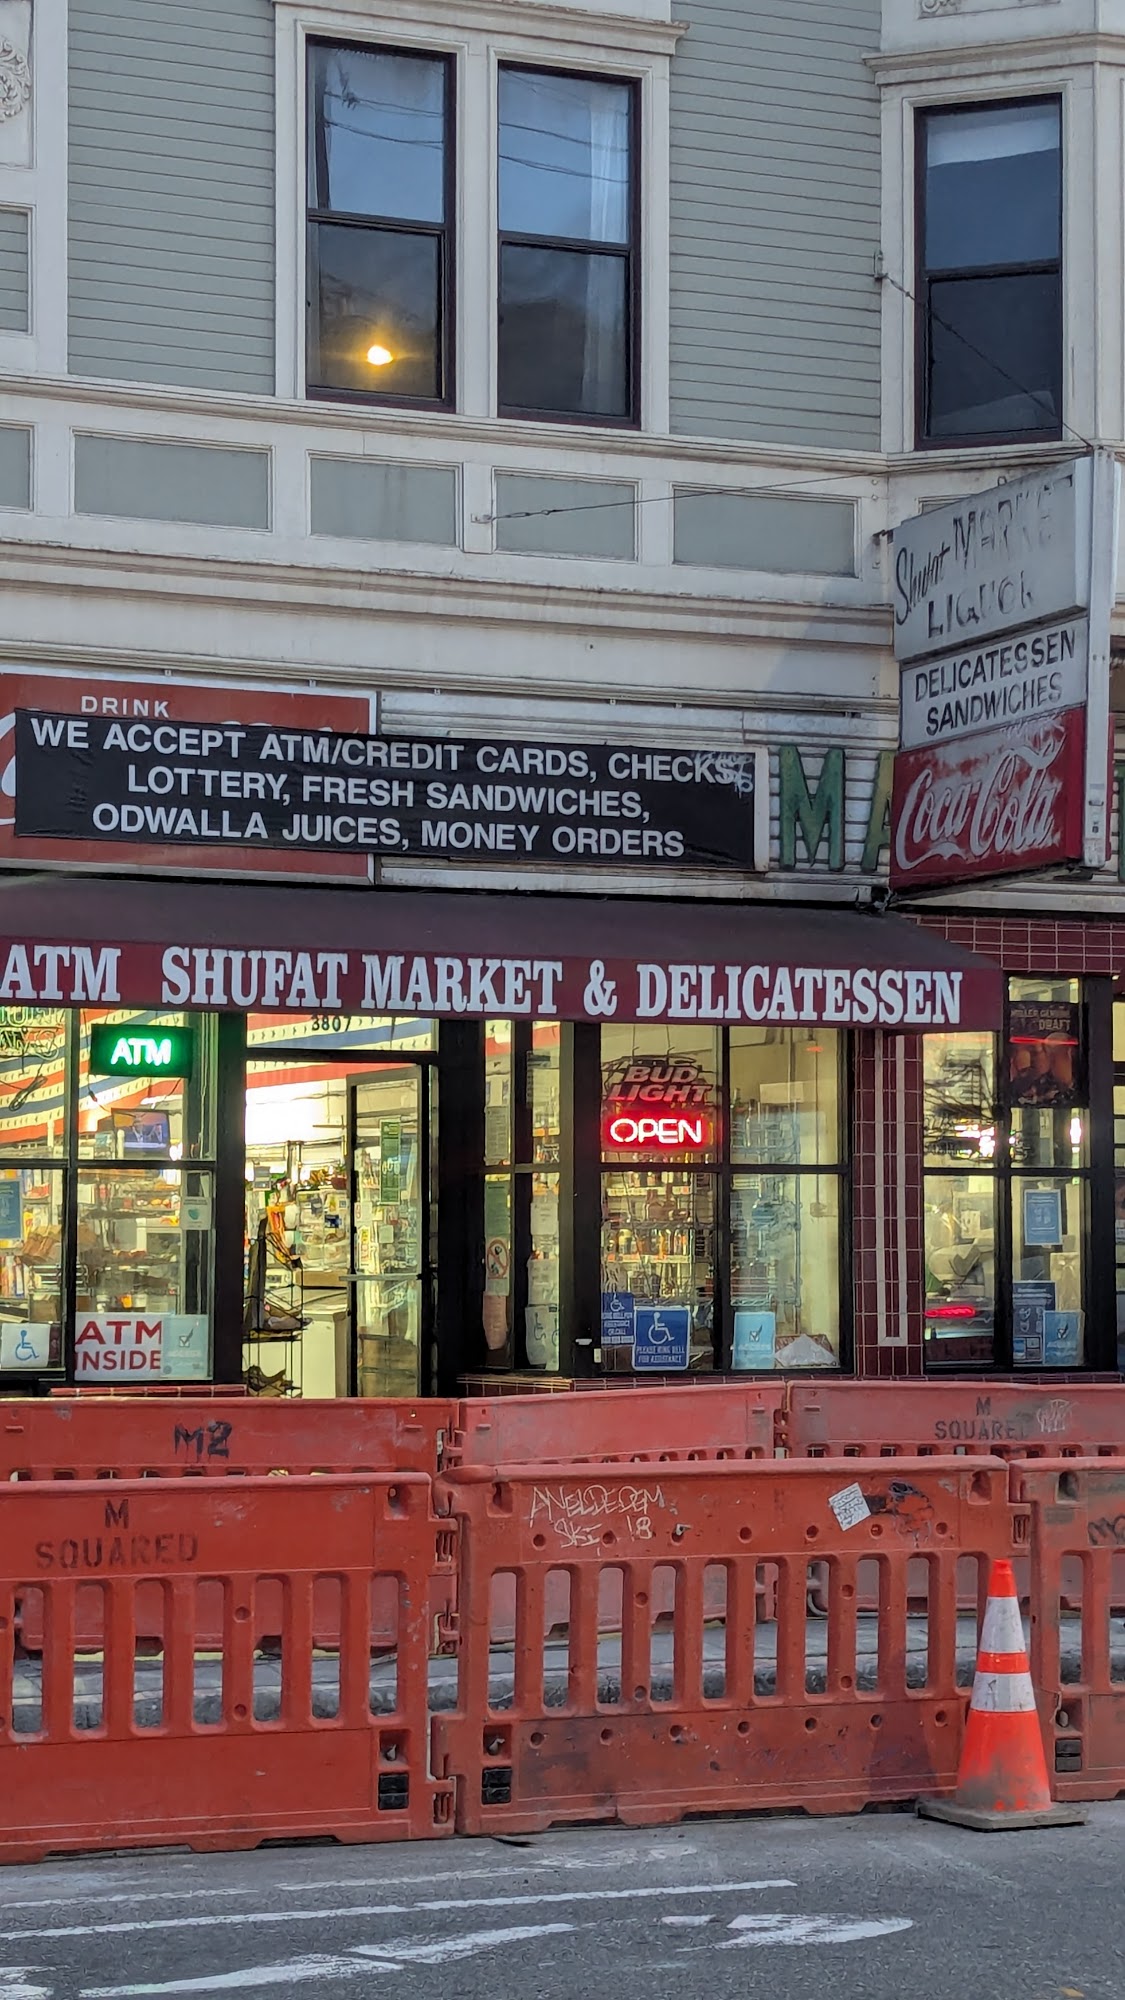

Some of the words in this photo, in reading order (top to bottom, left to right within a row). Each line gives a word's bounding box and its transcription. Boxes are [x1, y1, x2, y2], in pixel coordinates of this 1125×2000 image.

[915, 629, 1076, 701] DELICATESSEN
[81, 695, 170, 719] DRINK
[926, 672, 1063, 736] SANDWICHES
[30, 718, 90, 749] WE
[103, 723, 246, 759] ACCEPT
[259, 733, 465, 771] ATM/CREDIT
[476, 745, 598, 782] CARDS,
[607, 752, 738, 785] CHECKS
[128, 765, 291, 807] LOTTERY,
[303, 776, 414, 808] FRESH
[426, 782, 650, 824] SANDWICHES,
[92, 803, 268, 840] ODWALLA
[281, 814, 409, 851] JUICES,
[421, 820, 539, 852] MONEY
[551, 825, 685, 857] ORDERS
[0, 944, 122, 1002] ATM
[161, 946, 349, 1008] SHUFAT
[360, 954, 563, 1014] MARKET
[583, 959, 618, 1016] &
[636, 963, 963, 1024] DELICATESSEN
[311, 1014, 351, 1032] 3807
[110, 1037, 172, 1066] ATM
[623, 1066, 699, 1083] BUD
[607, 1084, 713, 1102] LIGHT
[610, 1118, 702, 1143] OPEN
[75, 1320, 162, 1345] ATM
[75, 1350, 161, 1371] INSIDE
[976, 1397, 991, 1416] M
[173, 1420, 233, 1458] M2
[105, 1499, 129, 1529] M
[35, 1533, 198, 1569] SQUARED
